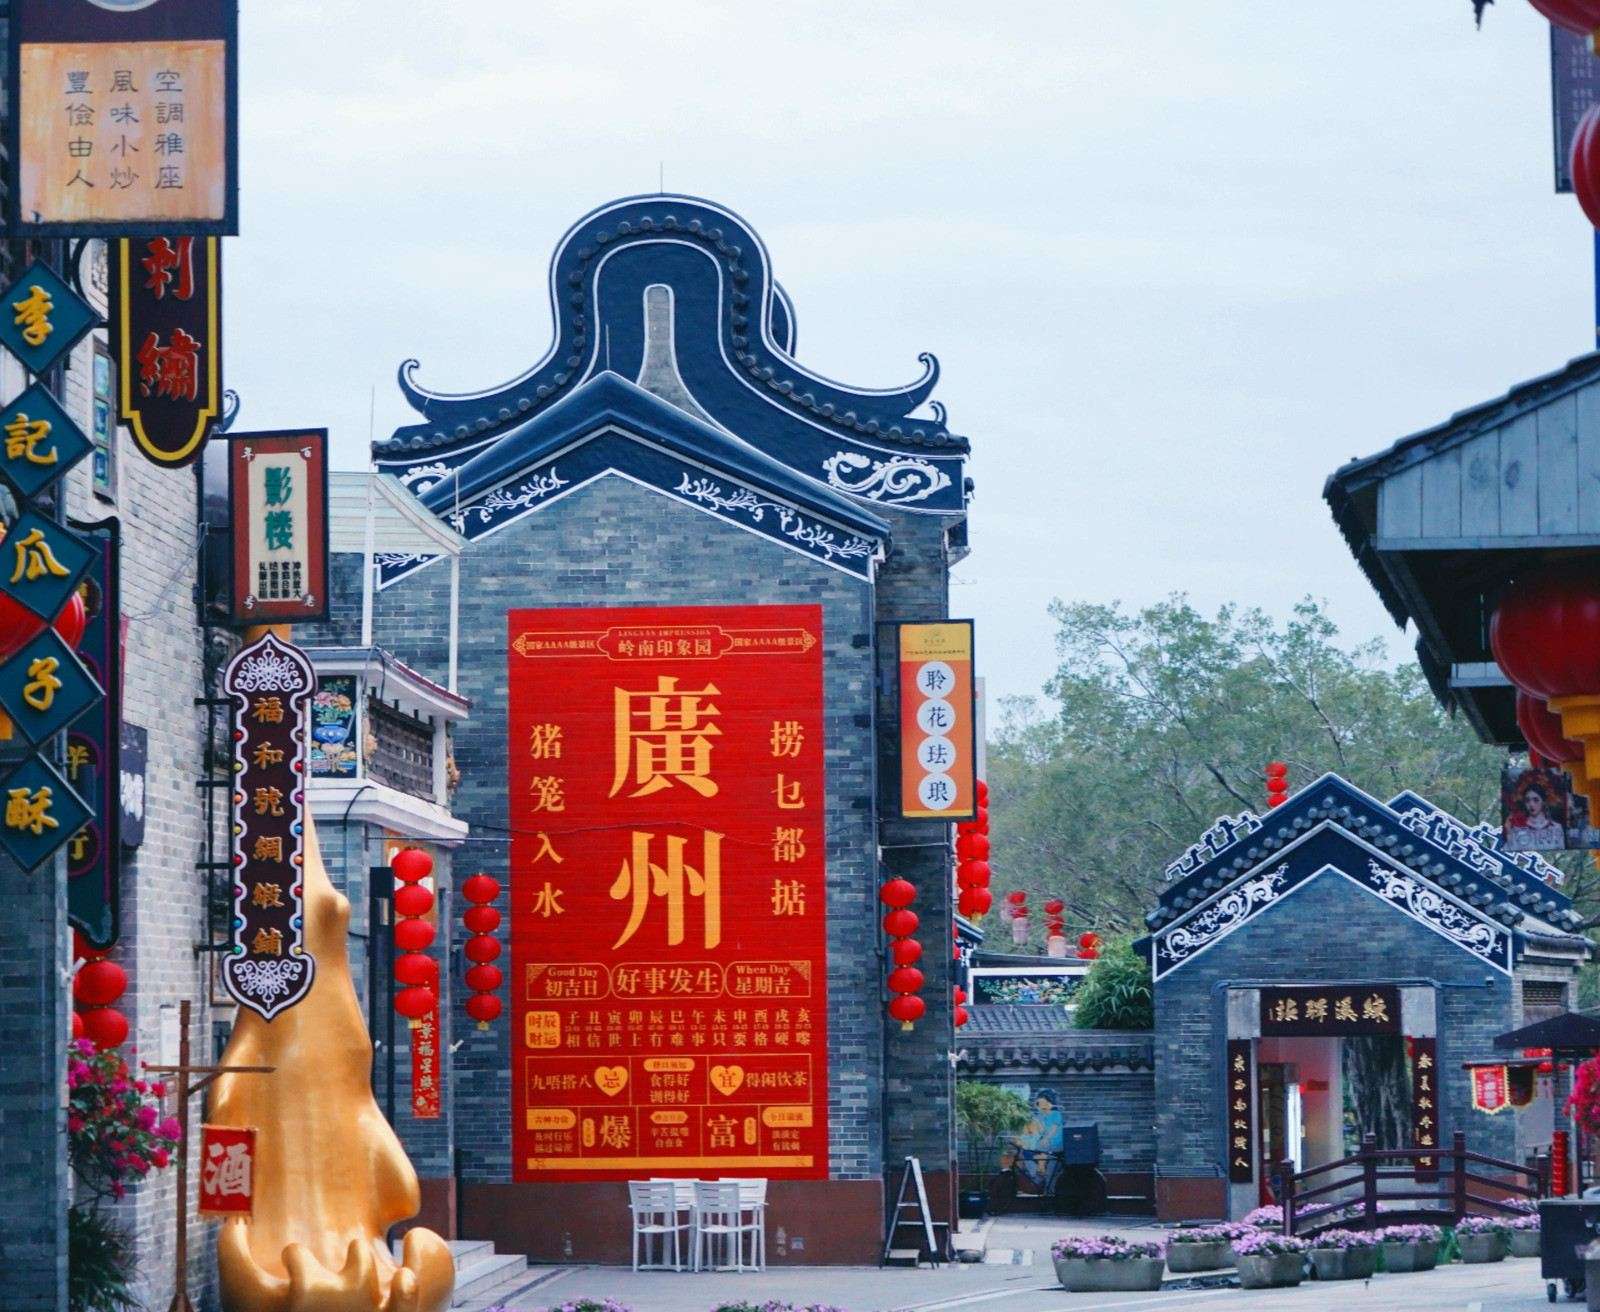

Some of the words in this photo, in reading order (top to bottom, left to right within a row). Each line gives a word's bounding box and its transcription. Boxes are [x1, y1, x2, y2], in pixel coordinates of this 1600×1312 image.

[65, 70, 95, 189] 豐儉由人
[109, 69, 140, 190] 風味小炒
[154, 68, 185, 190] 空調雅座
[264, 466, 293, 551] 影楼
[618, 638, 712, 657] 岭南印象园
[530, 723, 565, 918] 猪笼入水
[609, 675, 723, 950] 廣州
[770, 721, 805, 916] 捞乜都掂
[545, 979, 598, 996] 初吉日
[548, 967, 576, 978] Good
[578, 967, 599, 979] Day
[616, 967, 719, 995] 好事发生
[736, 964, 767, 975] When
[769, 964, 790, 975] Day
[736, 977, 791, 994] 星期吉
[718, 1069, 737, 1089] 宜
[600, 1114, 632, 1150] 爆
[707, 1113, 739, 1149] 富
[203, 1142, 252, 1197] 酒
